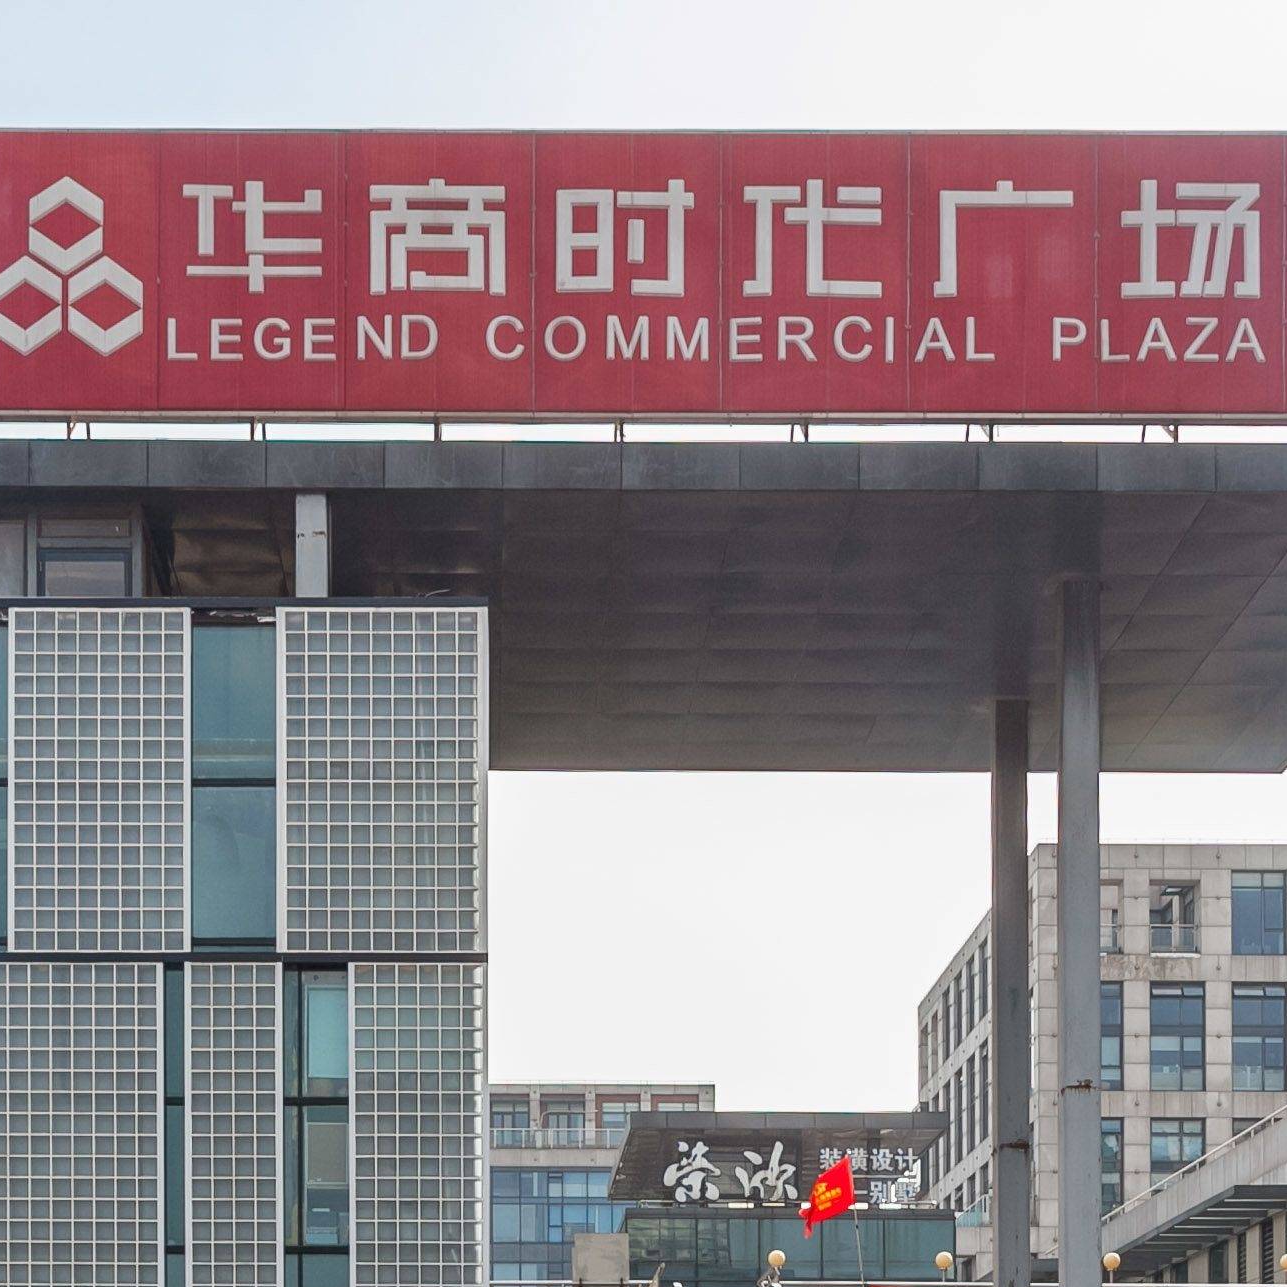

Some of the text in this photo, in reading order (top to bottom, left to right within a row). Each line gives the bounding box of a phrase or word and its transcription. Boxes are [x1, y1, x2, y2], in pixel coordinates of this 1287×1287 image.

[181, 178, 1262, 298] 华商时代广场
[167, 313, 1267, 364] LEGEND COMMERCIAL PLAZA
